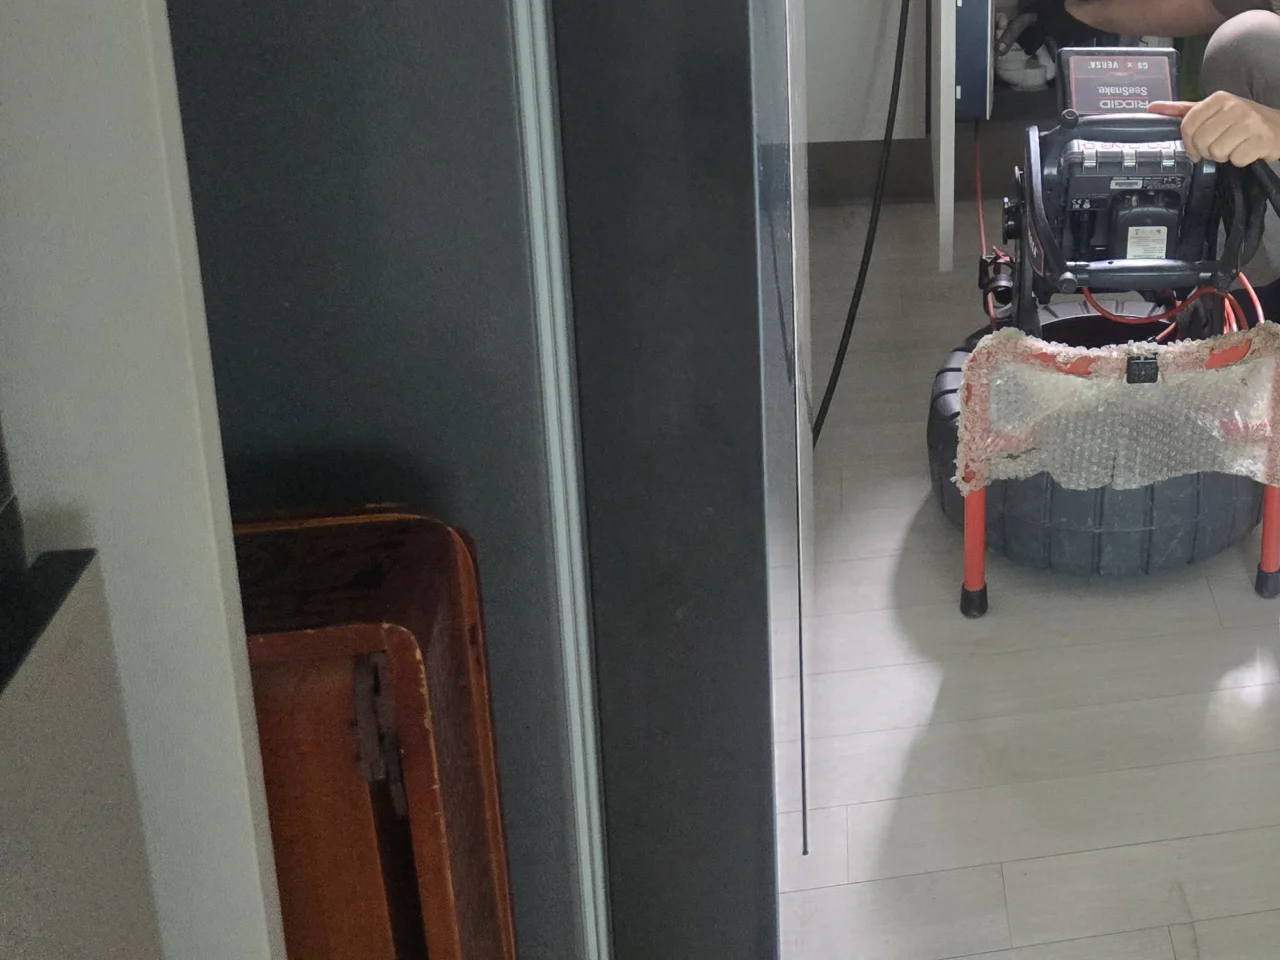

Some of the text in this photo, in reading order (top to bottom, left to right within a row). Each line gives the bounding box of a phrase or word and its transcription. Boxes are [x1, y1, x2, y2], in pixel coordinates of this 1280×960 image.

[1090, 61, 1119, 69] VERSA
[1137, 61, 1148, 69] CS
[1099, 86, 1148, 96] SeeSnake
[1099, 100, 1148, 109] RIDGID
